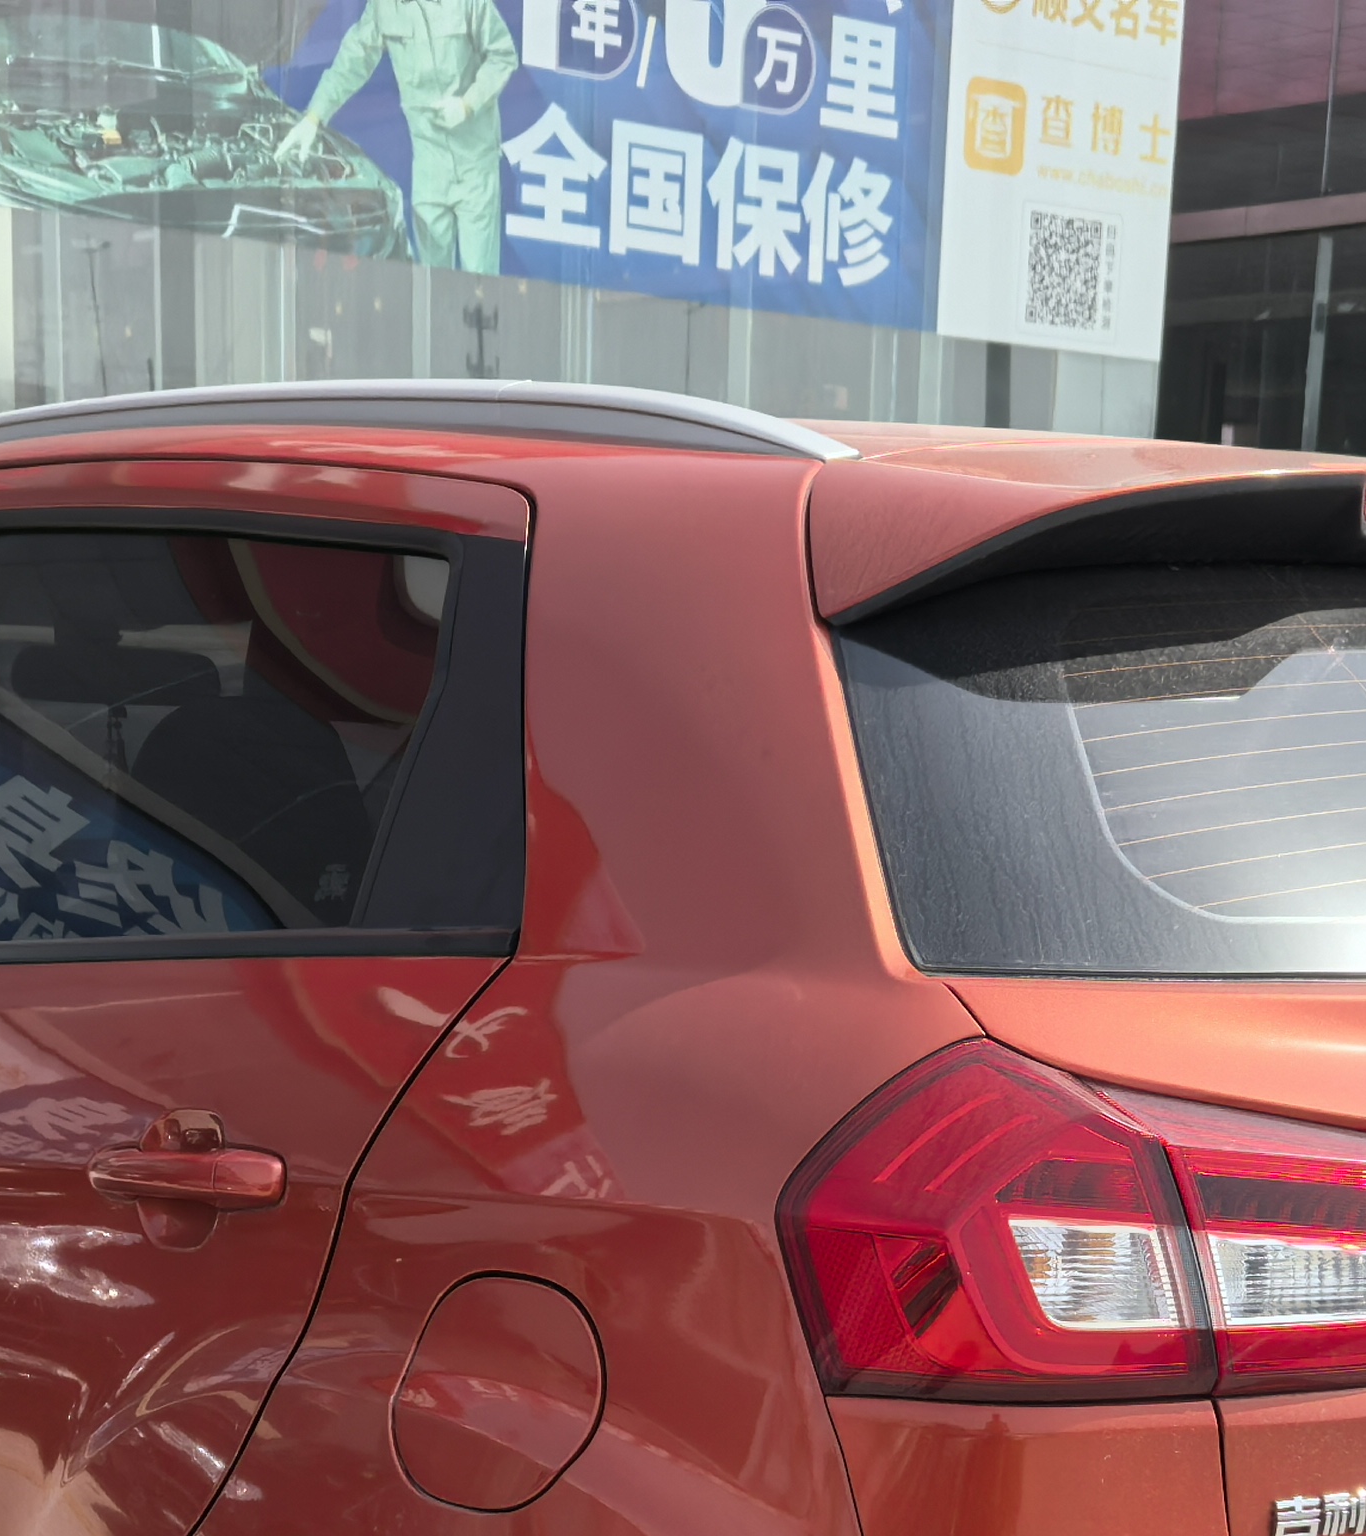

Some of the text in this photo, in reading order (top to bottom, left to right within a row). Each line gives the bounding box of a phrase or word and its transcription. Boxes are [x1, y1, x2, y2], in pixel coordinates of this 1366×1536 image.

[501, 102, 894, 287] 全国保修
[1039, 95, 1171, 166] 查博士
